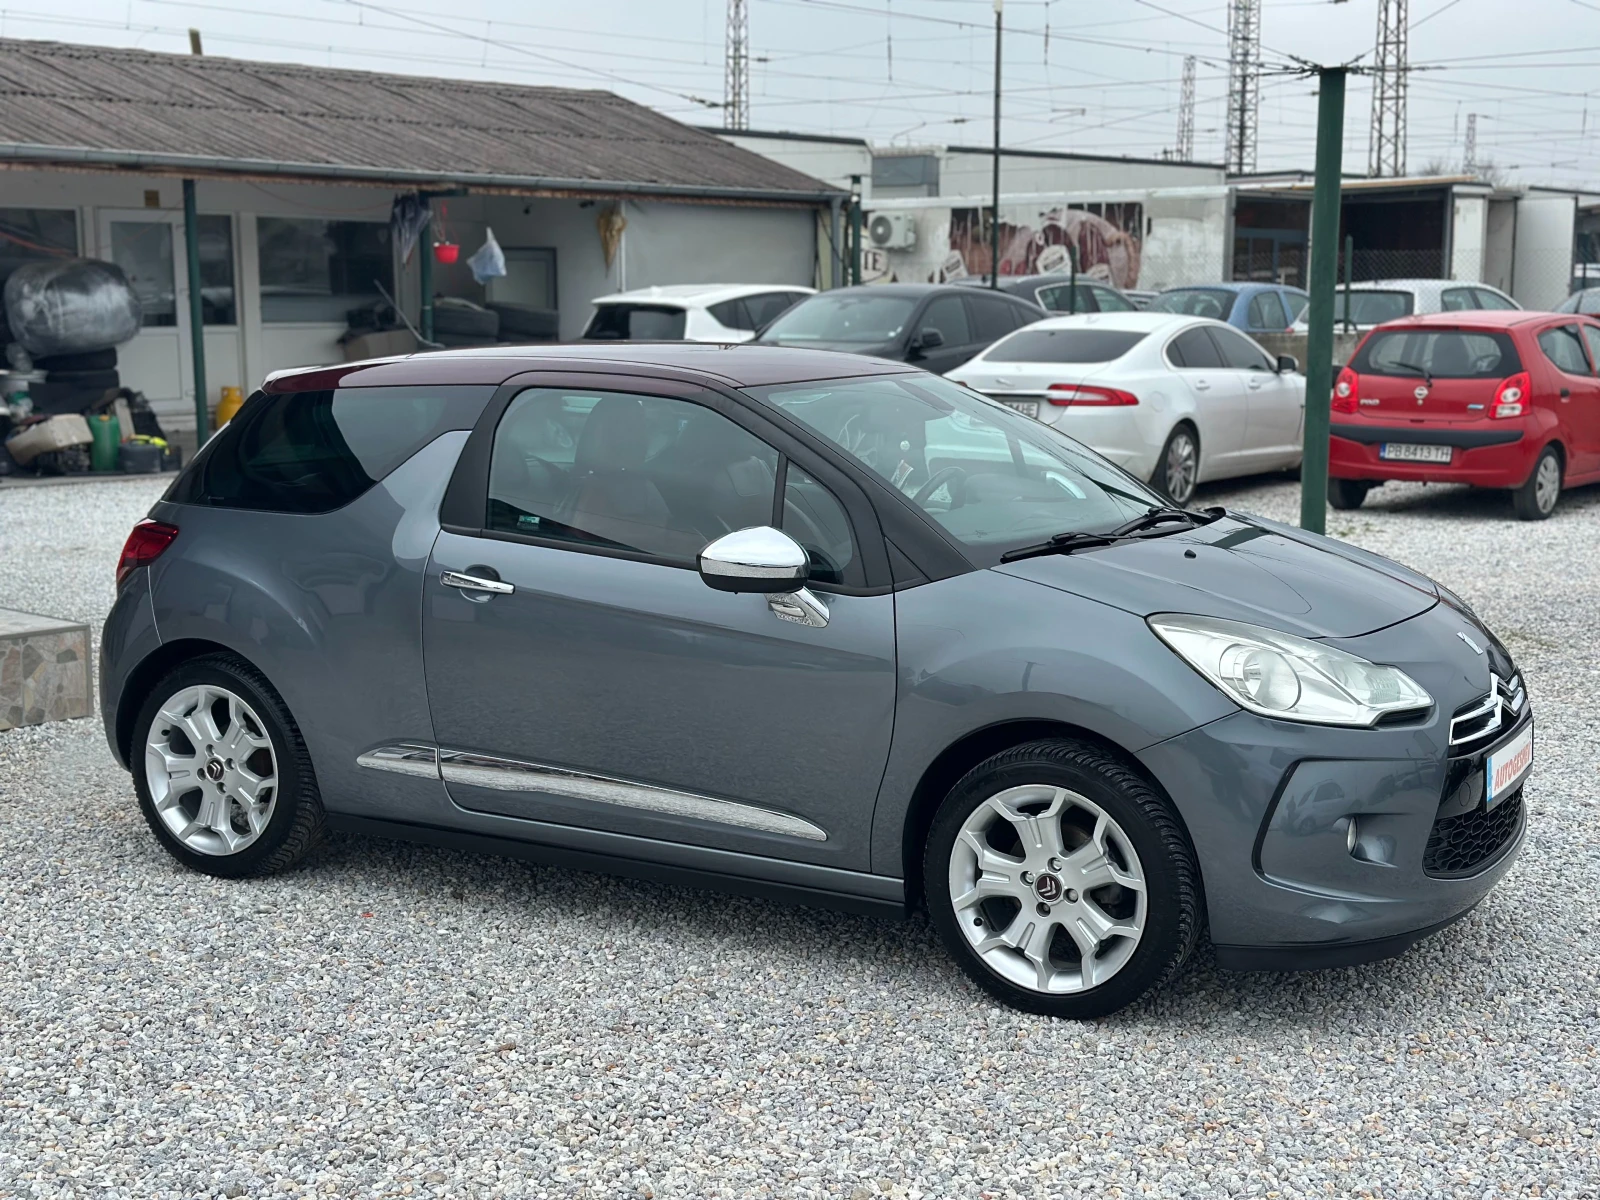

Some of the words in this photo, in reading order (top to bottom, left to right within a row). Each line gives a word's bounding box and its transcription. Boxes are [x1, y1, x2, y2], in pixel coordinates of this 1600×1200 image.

[1387, 443, 1402, 457] PB
[1404, 445, 1432, 459] 8413
[1434, 446, 1450, 460] TH
